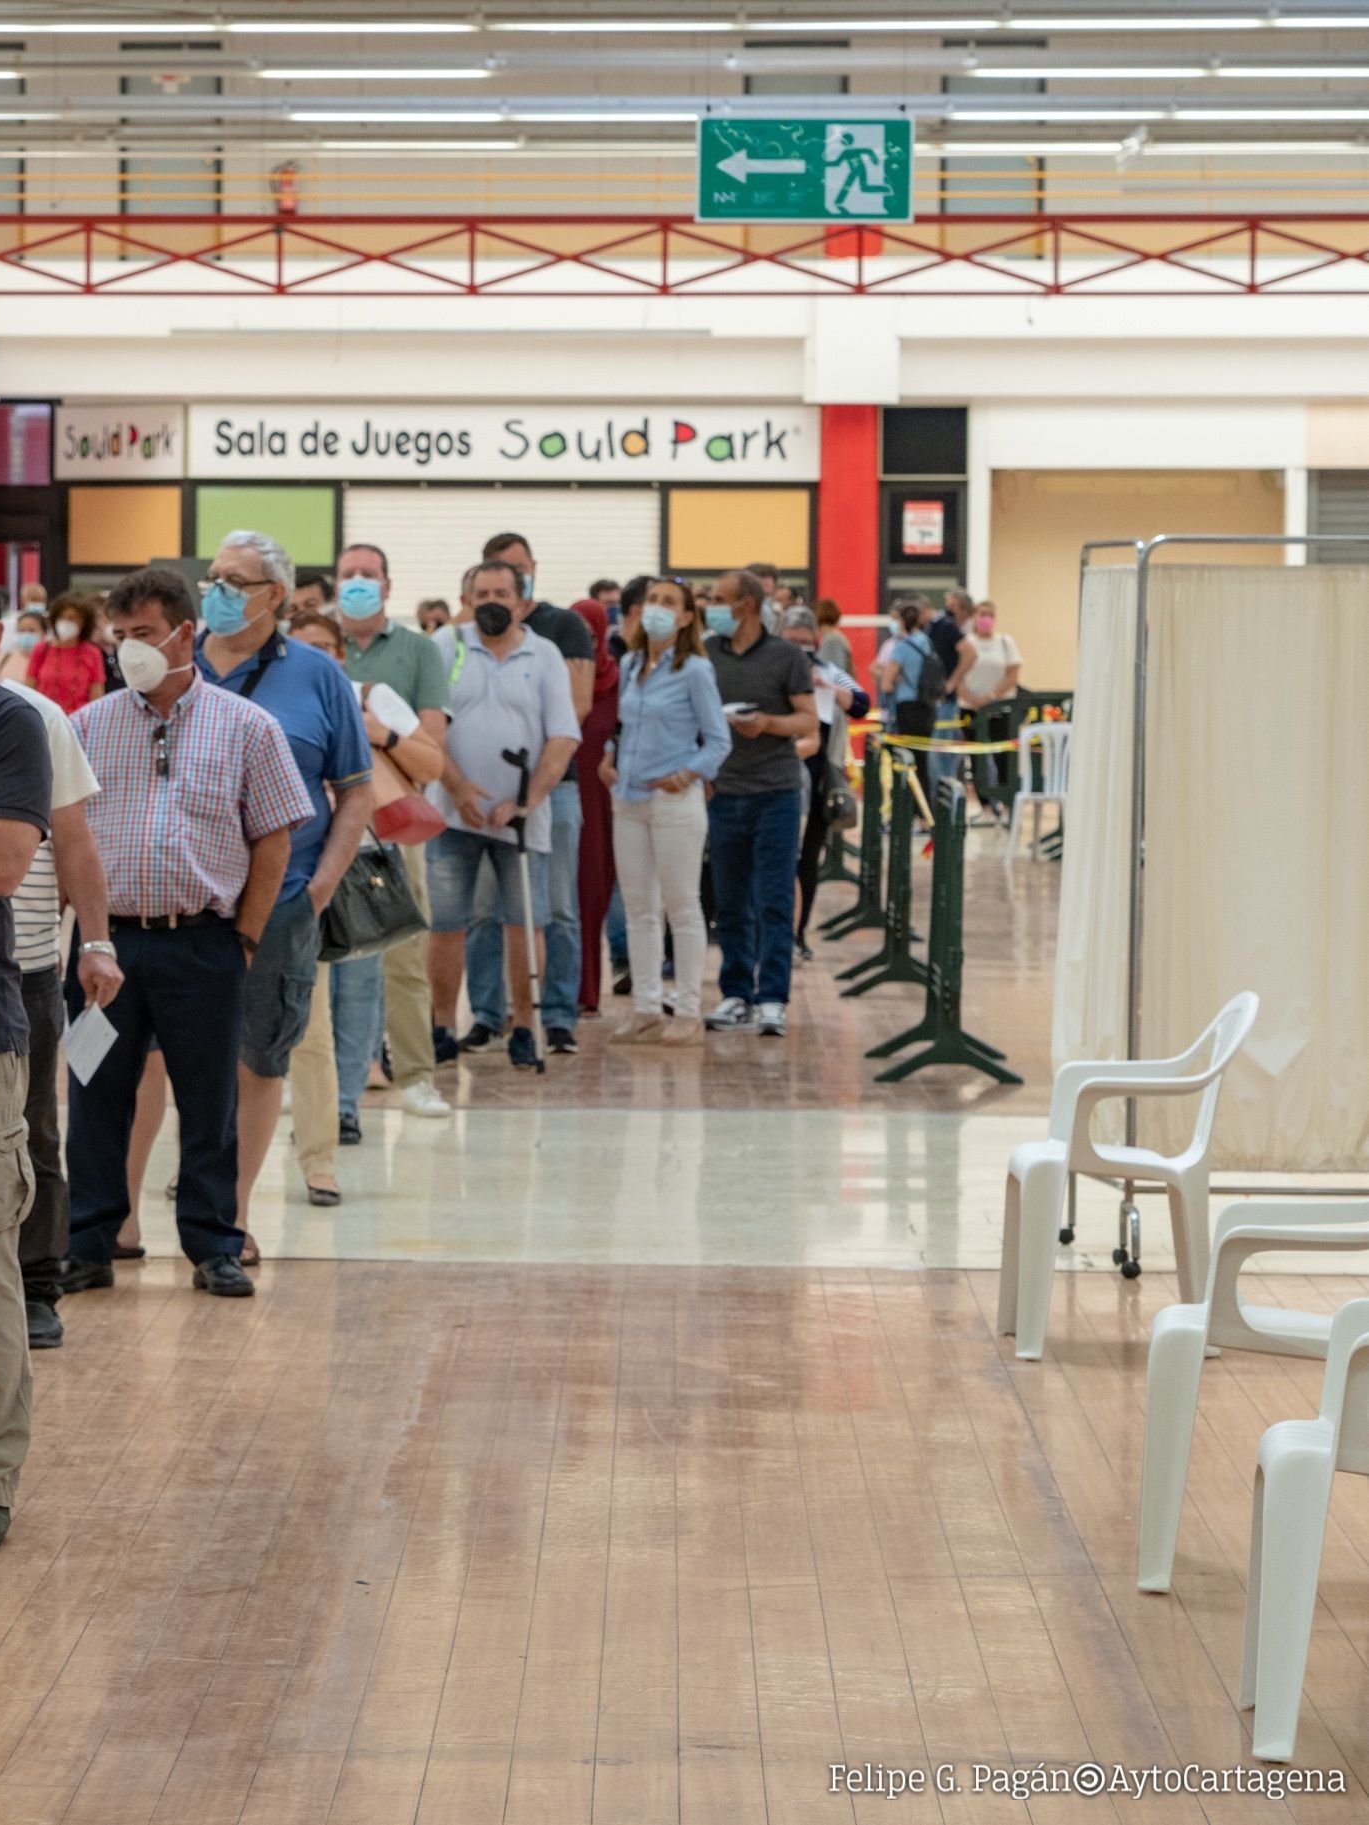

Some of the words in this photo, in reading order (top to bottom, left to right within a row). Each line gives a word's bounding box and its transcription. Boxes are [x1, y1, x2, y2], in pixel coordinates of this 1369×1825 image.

[63, 421, 123, 460] Sould
[127, 420, 176, 460] Park
[214, 419, 287, 457] Sala
[299, 421, 340, 457] de
[351, 420, 472, 467] Juegos
[498, 417, 651, 462] Sould
[670, 418, 788, 462] Park
